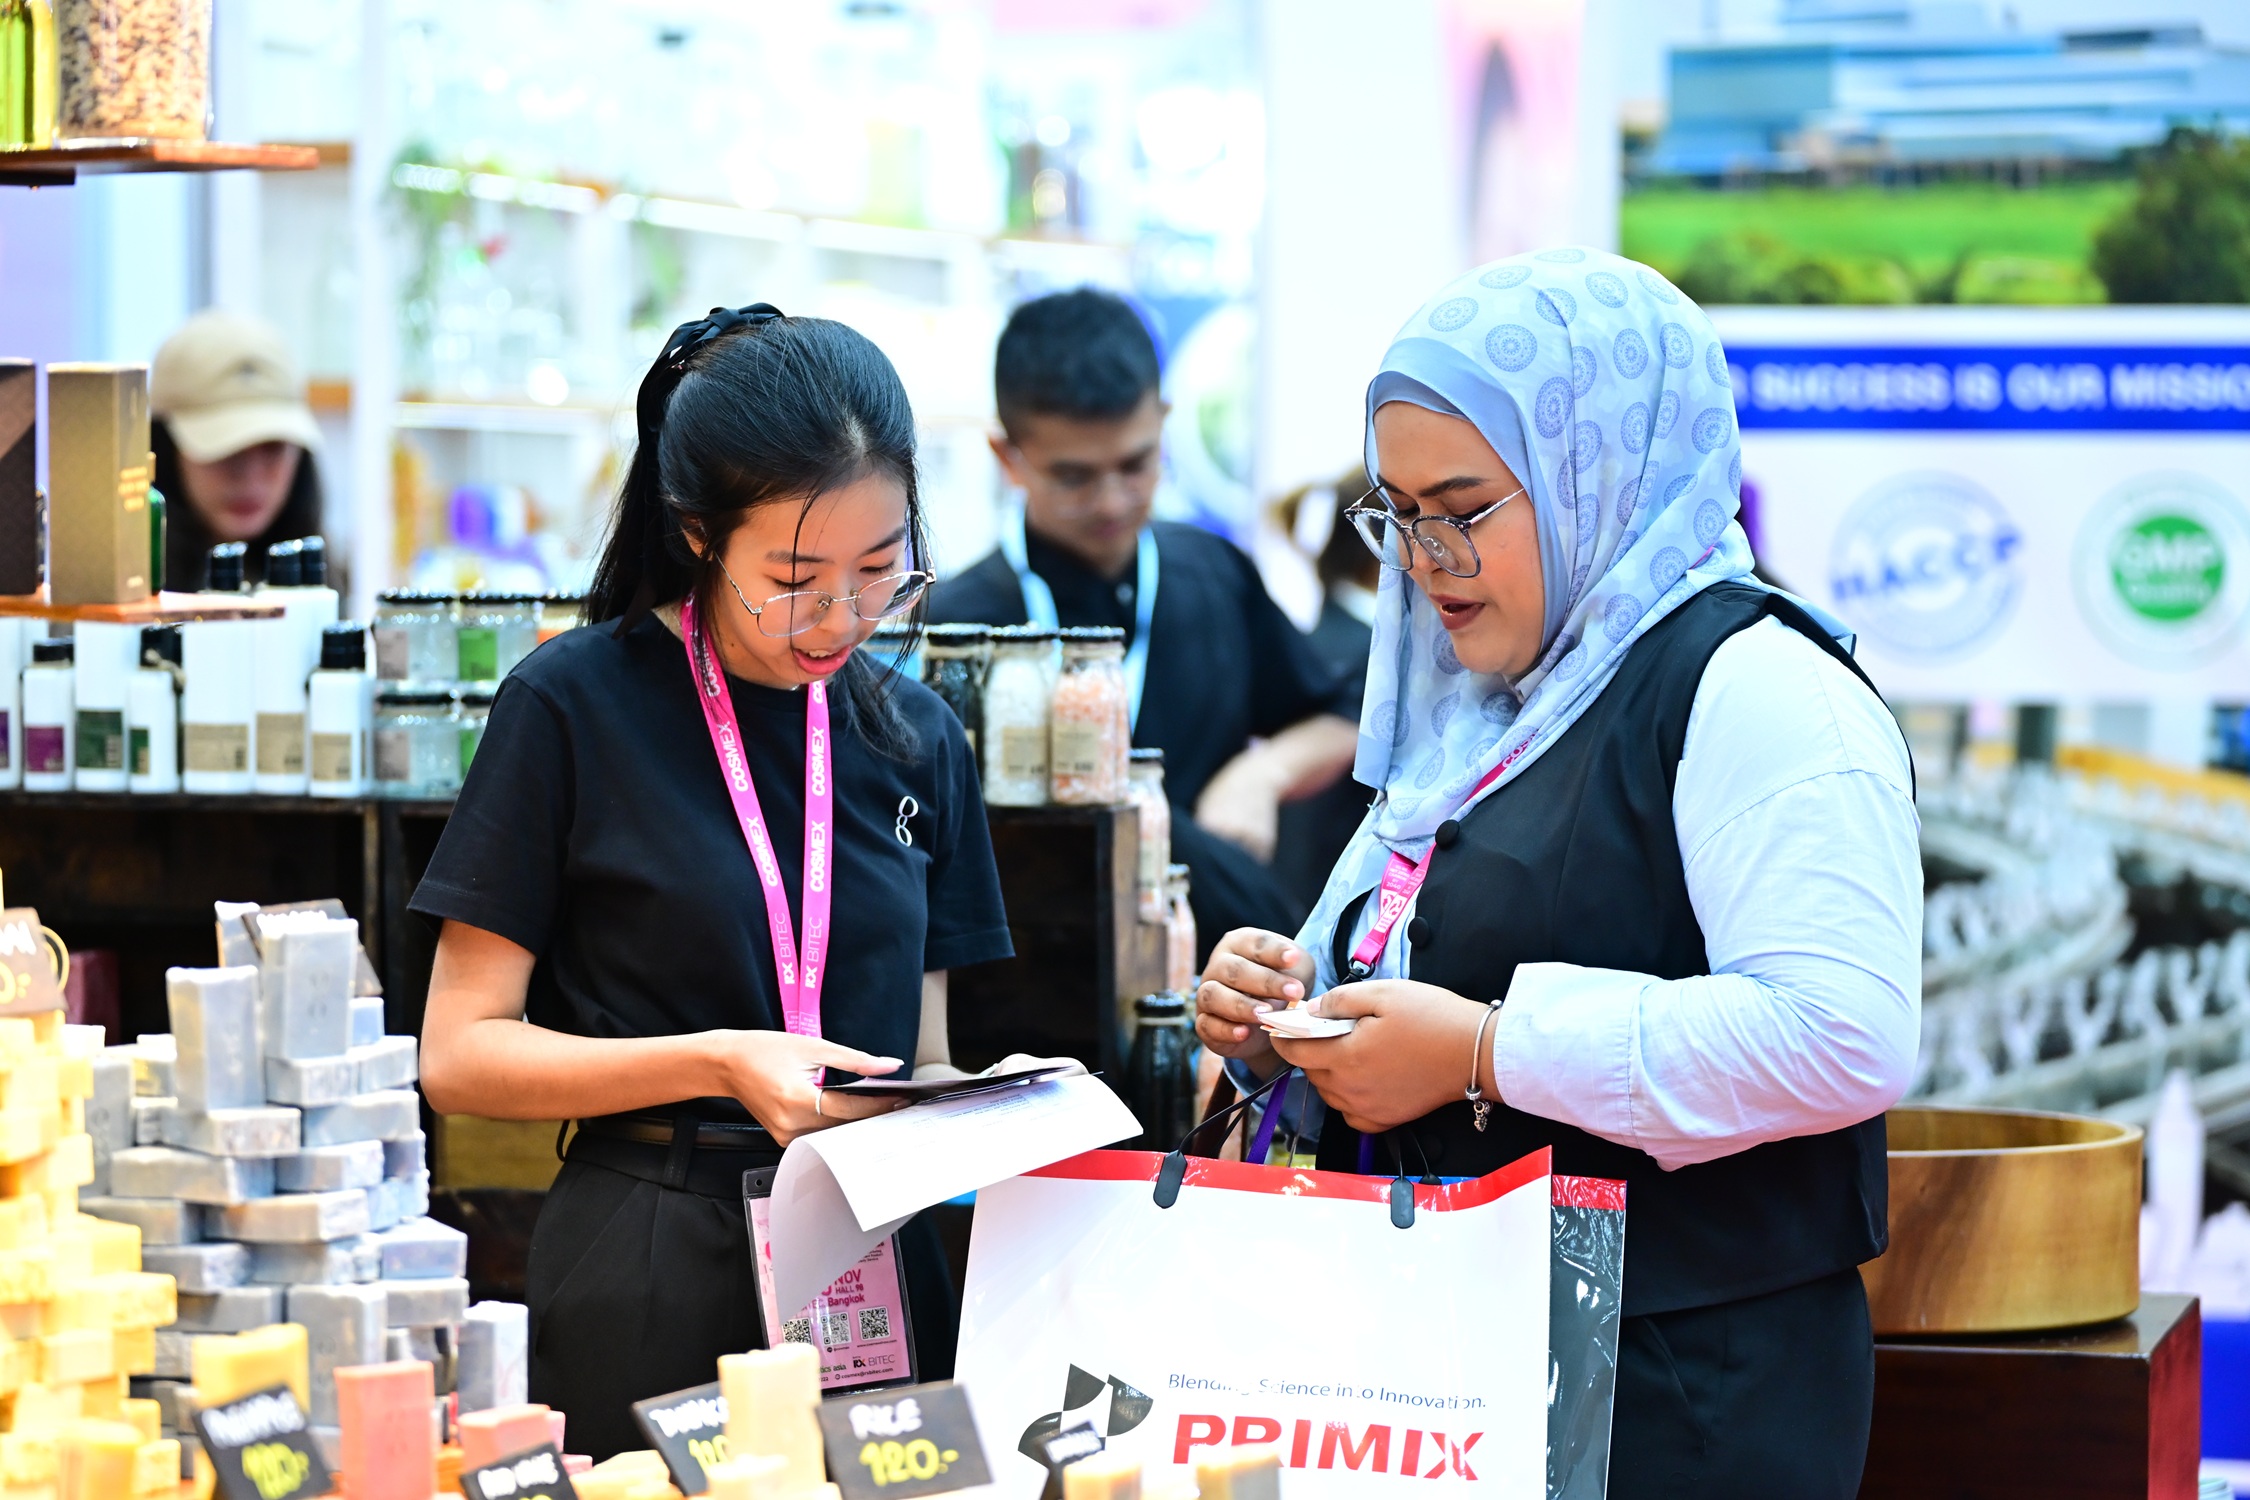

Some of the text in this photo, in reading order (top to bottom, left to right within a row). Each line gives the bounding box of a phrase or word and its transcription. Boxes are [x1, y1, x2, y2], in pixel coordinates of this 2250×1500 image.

[717, 721, 748, 792] COSMEX
[811, 726, 825, 796] COSMEX
[746, 816, 778, 886] COSMEX
[810, 820, 825, 892] COSMEX
[775, 912, 791, 958] BITEC
[807, 917, 822, 962] BITEC
[827, 1293, 865, 1307] Bangkok
[835, 1285, 854, 1294] HALL
[868, 1354, 895, 1367] BITEC
[1173, 1414, 1485, 1481] PRIMIX
